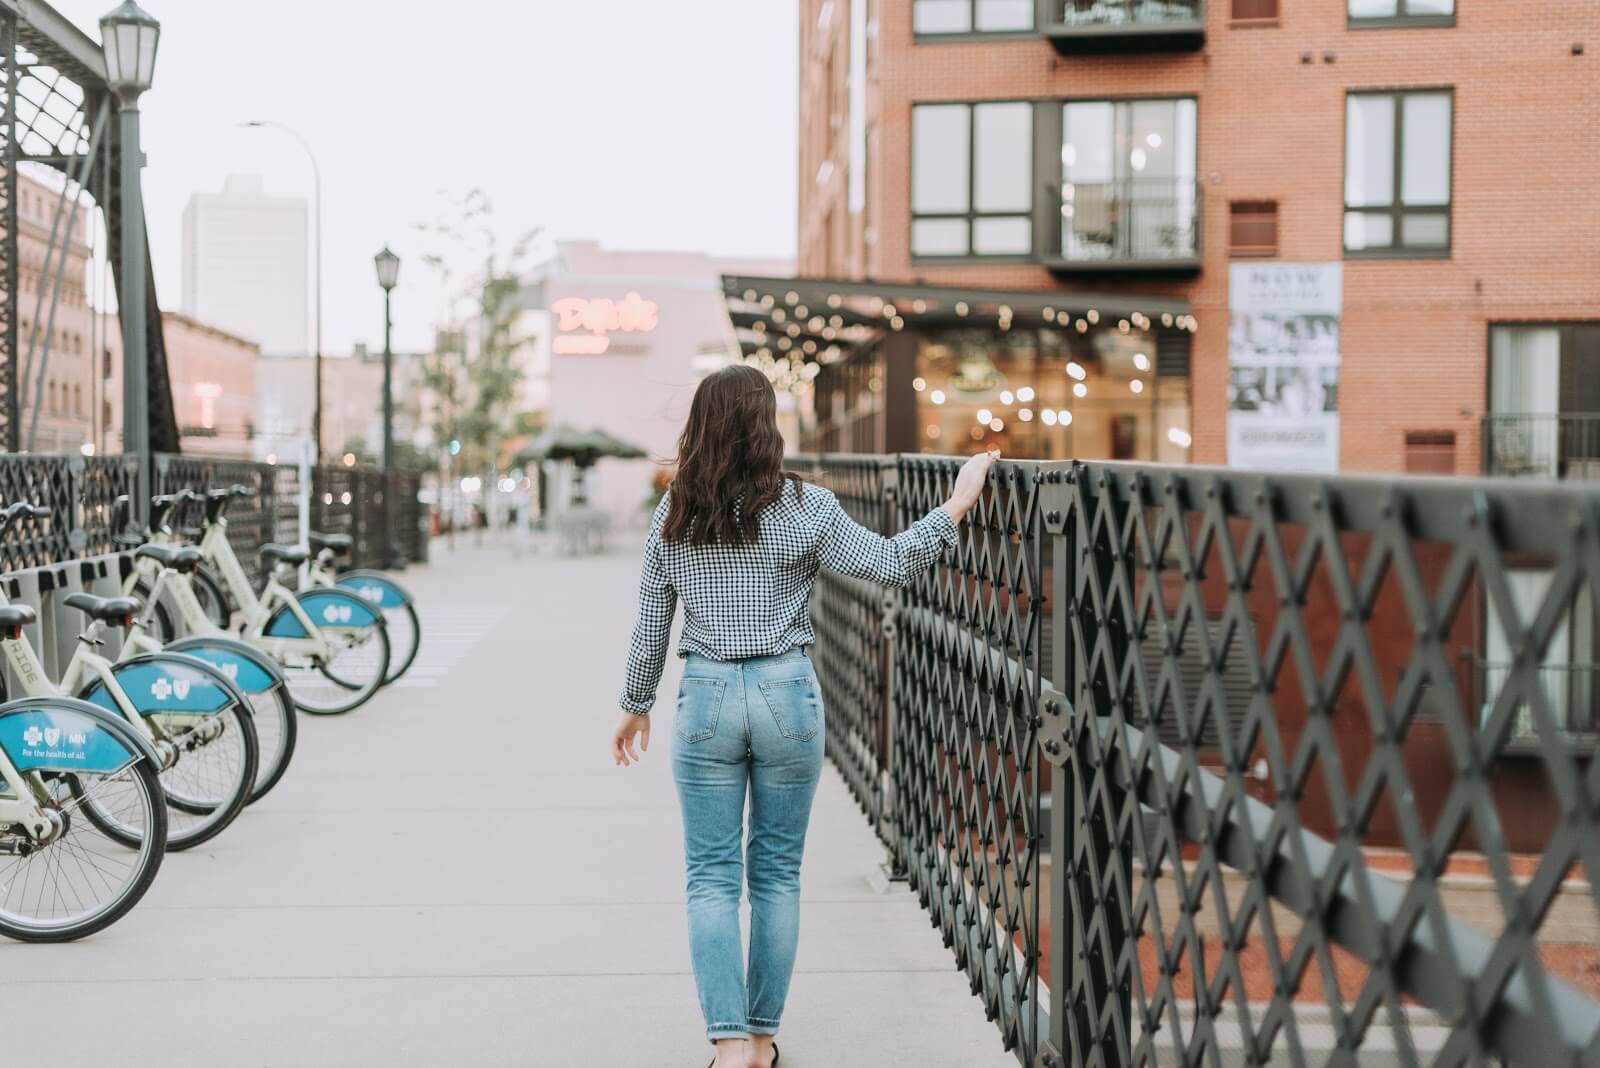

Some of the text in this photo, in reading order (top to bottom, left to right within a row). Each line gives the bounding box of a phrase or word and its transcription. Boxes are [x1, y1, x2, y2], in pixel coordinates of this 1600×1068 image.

[1249, 270, 1320, 287] NOW
[10, 642, 39, 684] RIDE
[69, 733, 86, 745] MN
[33, 749, 45, 758] the
[46, 750, 66, 759] health
[67, 751, 75, 759] of
